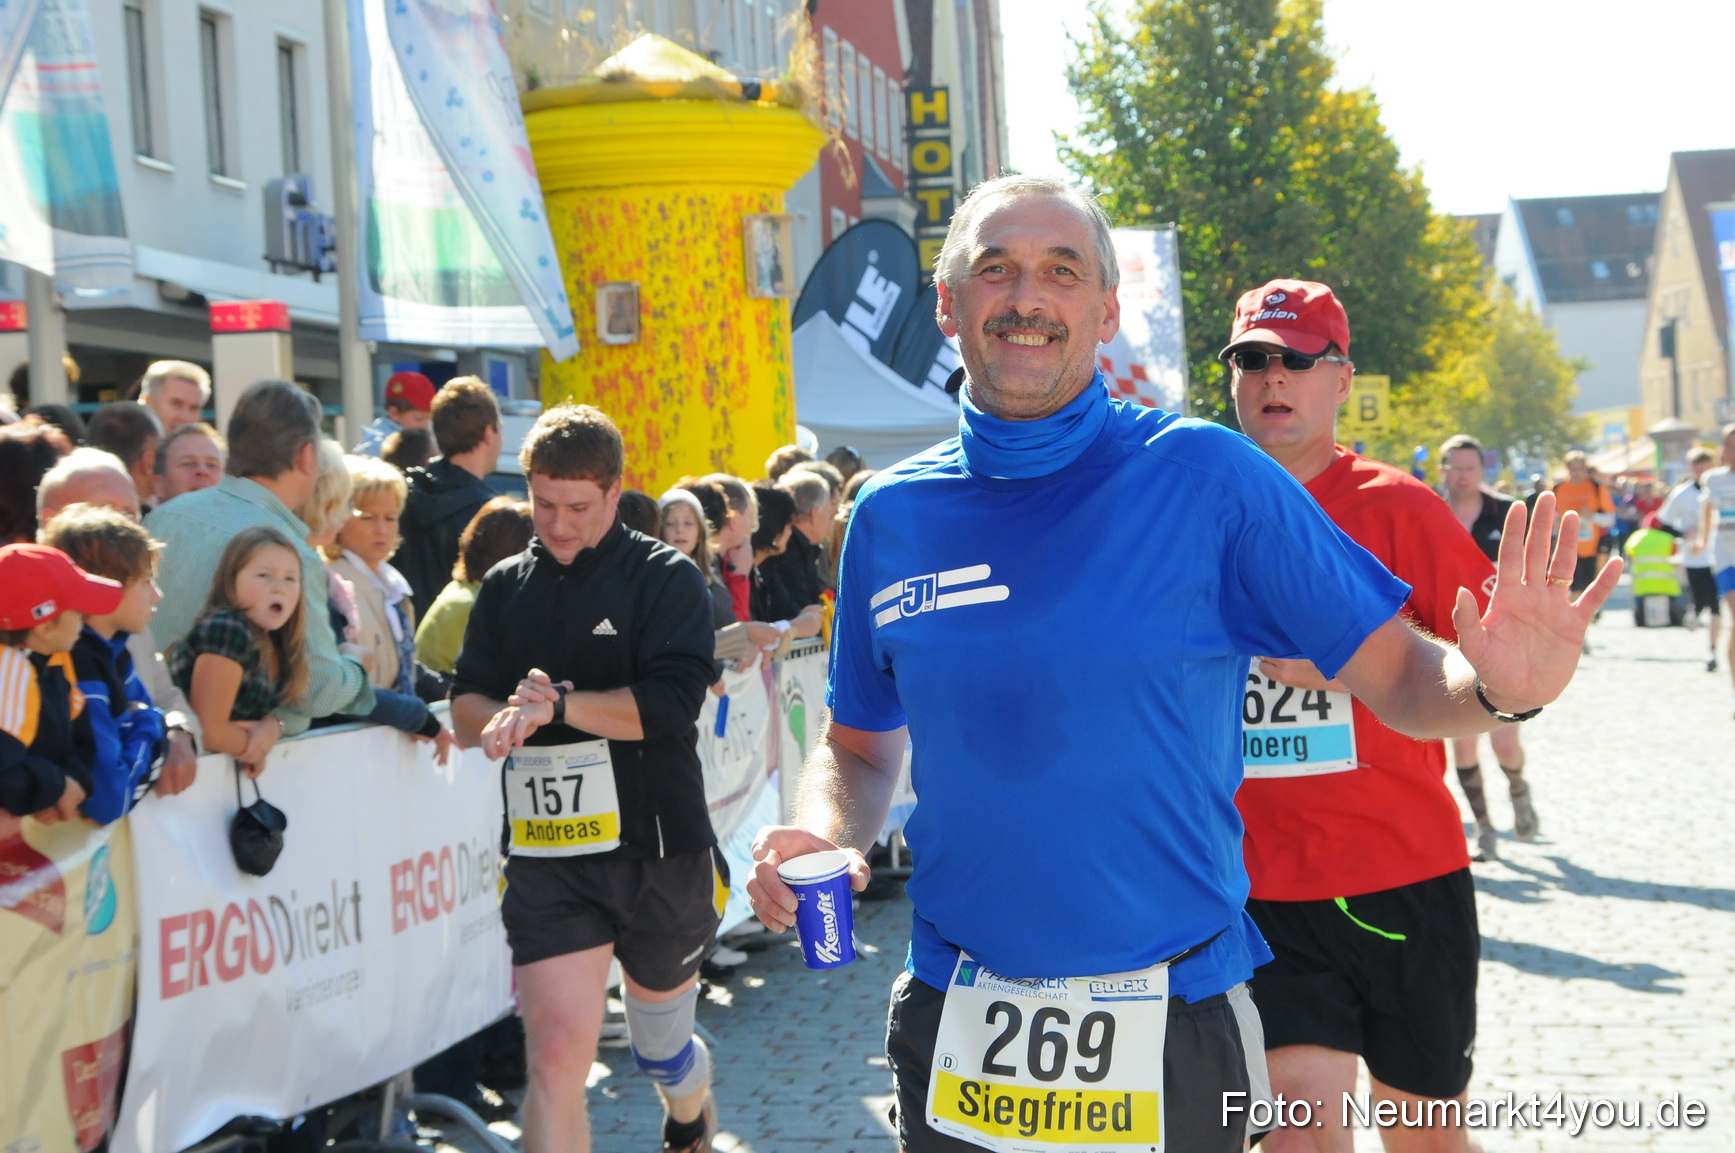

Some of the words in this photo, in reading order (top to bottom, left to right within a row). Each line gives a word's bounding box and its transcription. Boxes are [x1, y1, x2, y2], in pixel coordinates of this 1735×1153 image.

[1360, 395, 1378, 421] B
[525, 774, 583, 816] 157
[526, 820, 601, 841] Andreas
[977, 981, 1068, 1001] AKTIENGESELLSCHAFT
[1089, 978, 1148, 994] BOCK
[981, 1000, 1116, 1083] 269
[943, 1056, 953, 1069] D
[958, 1081, 1132, 1137] Siegfried
